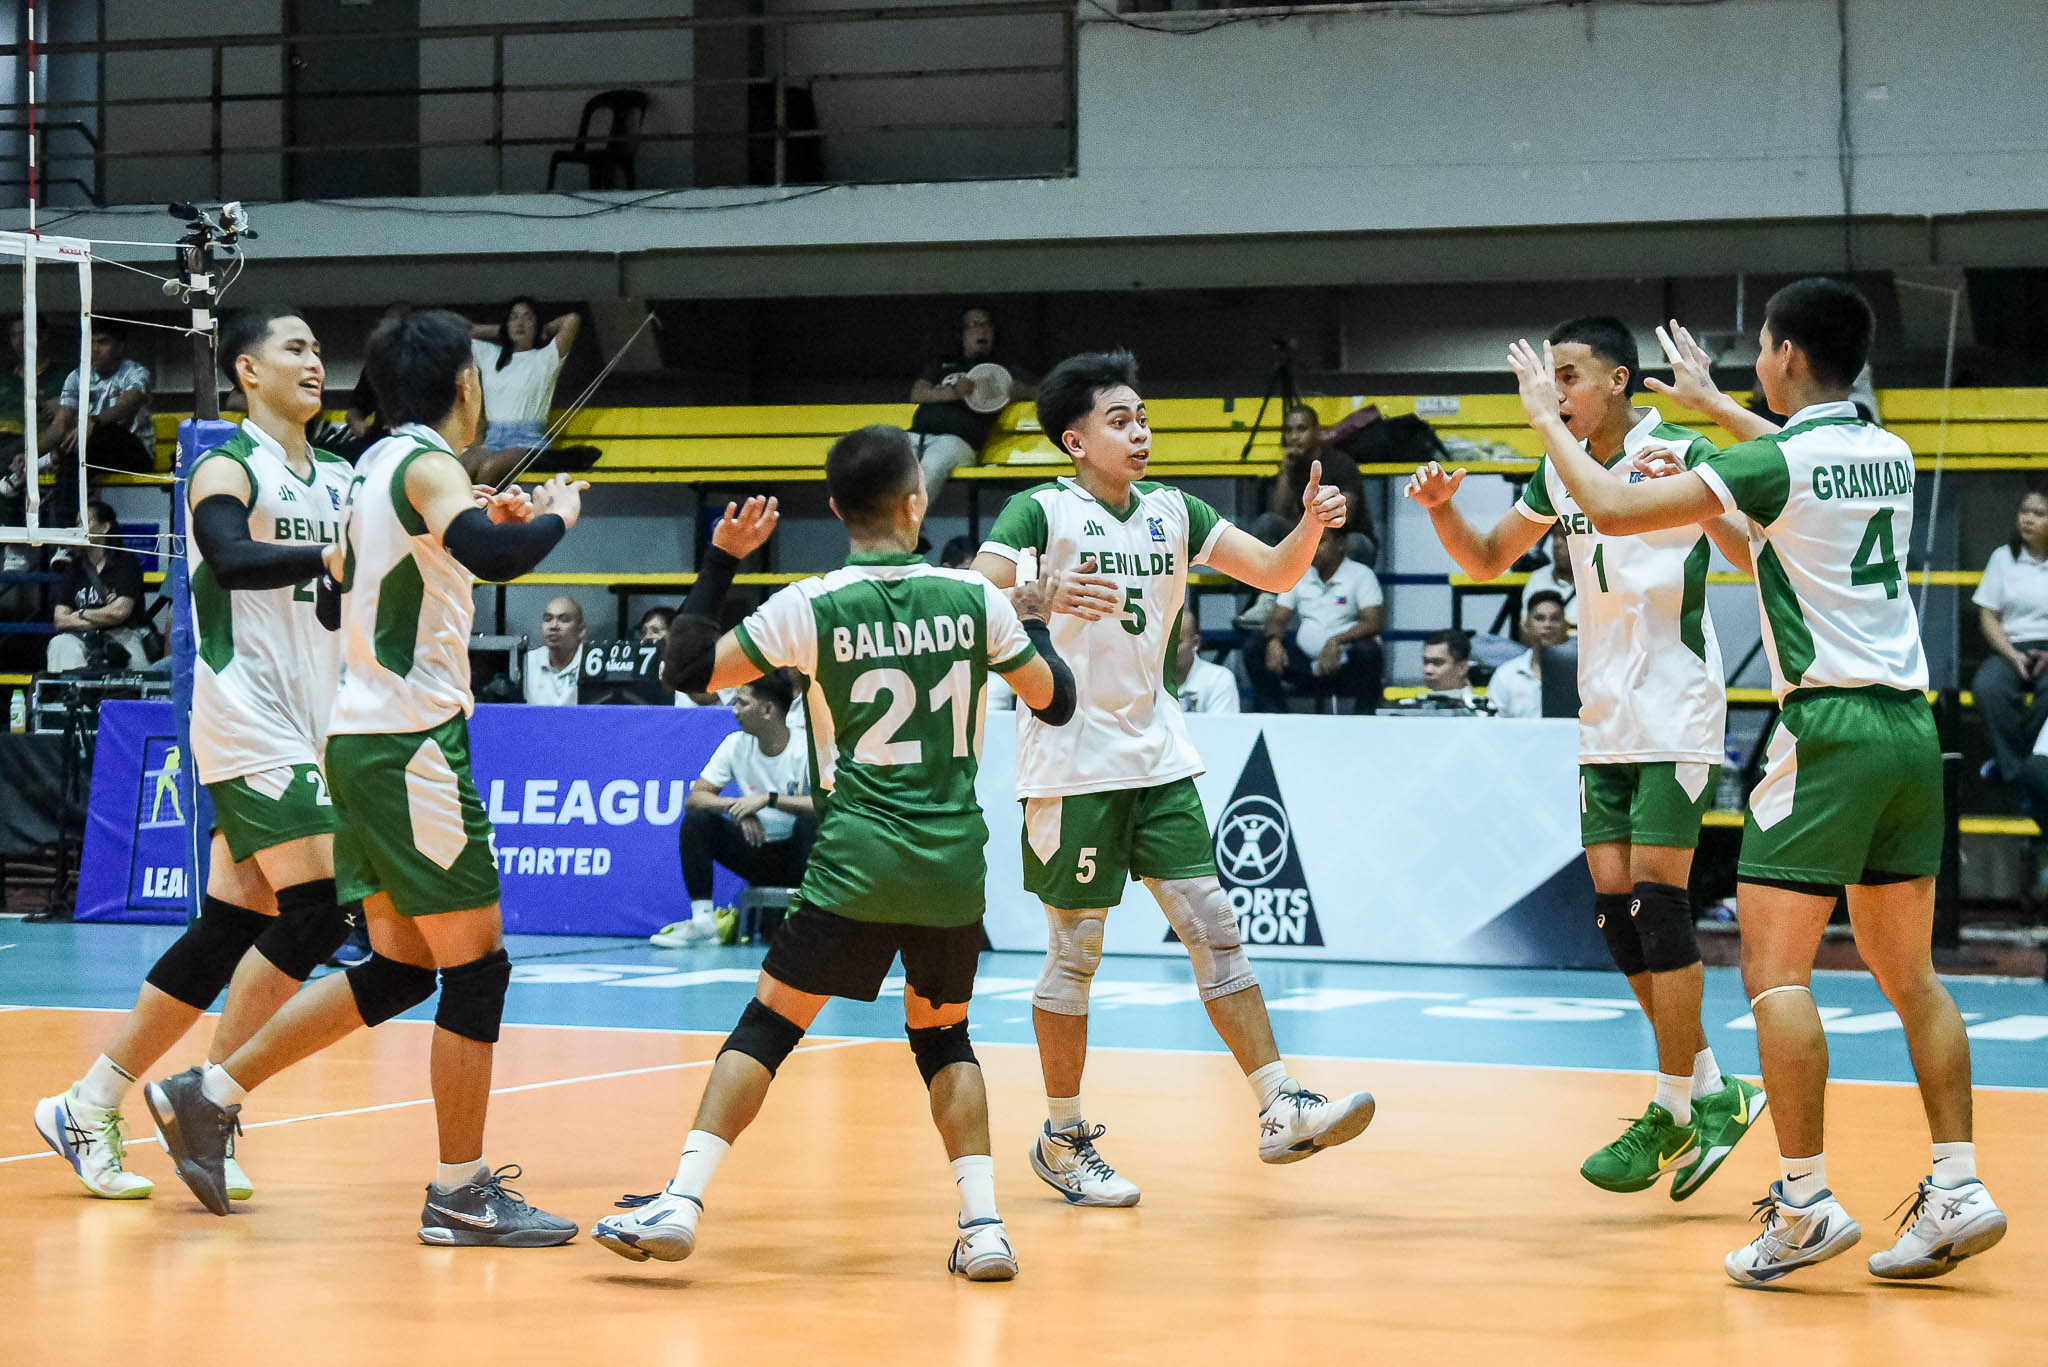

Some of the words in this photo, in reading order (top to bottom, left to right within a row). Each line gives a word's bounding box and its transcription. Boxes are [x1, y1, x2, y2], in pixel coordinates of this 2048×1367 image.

[1080, 551, 1174, 577] BENILDE
[1591, 543, 1609, 593] 1
[1850, 506, 1902, 600] 4
[1120, 586, 1147, 636] 5
[832, 613, 976, 663] BALDADO
[585, 647, 604, 677] 6
[639, 647, 657, 676] 7
[849, 659, 972, 767] 21
[483, 778, 694, 826] LEAGU
[498, 846, 612, 876] TARTED
[1075, 847, 1098, 884] 5
[141, 866, 188, 898] LEA
[1221, 886, 1310, 919] ORTS
[1238, 914, 1308, 945] ION
